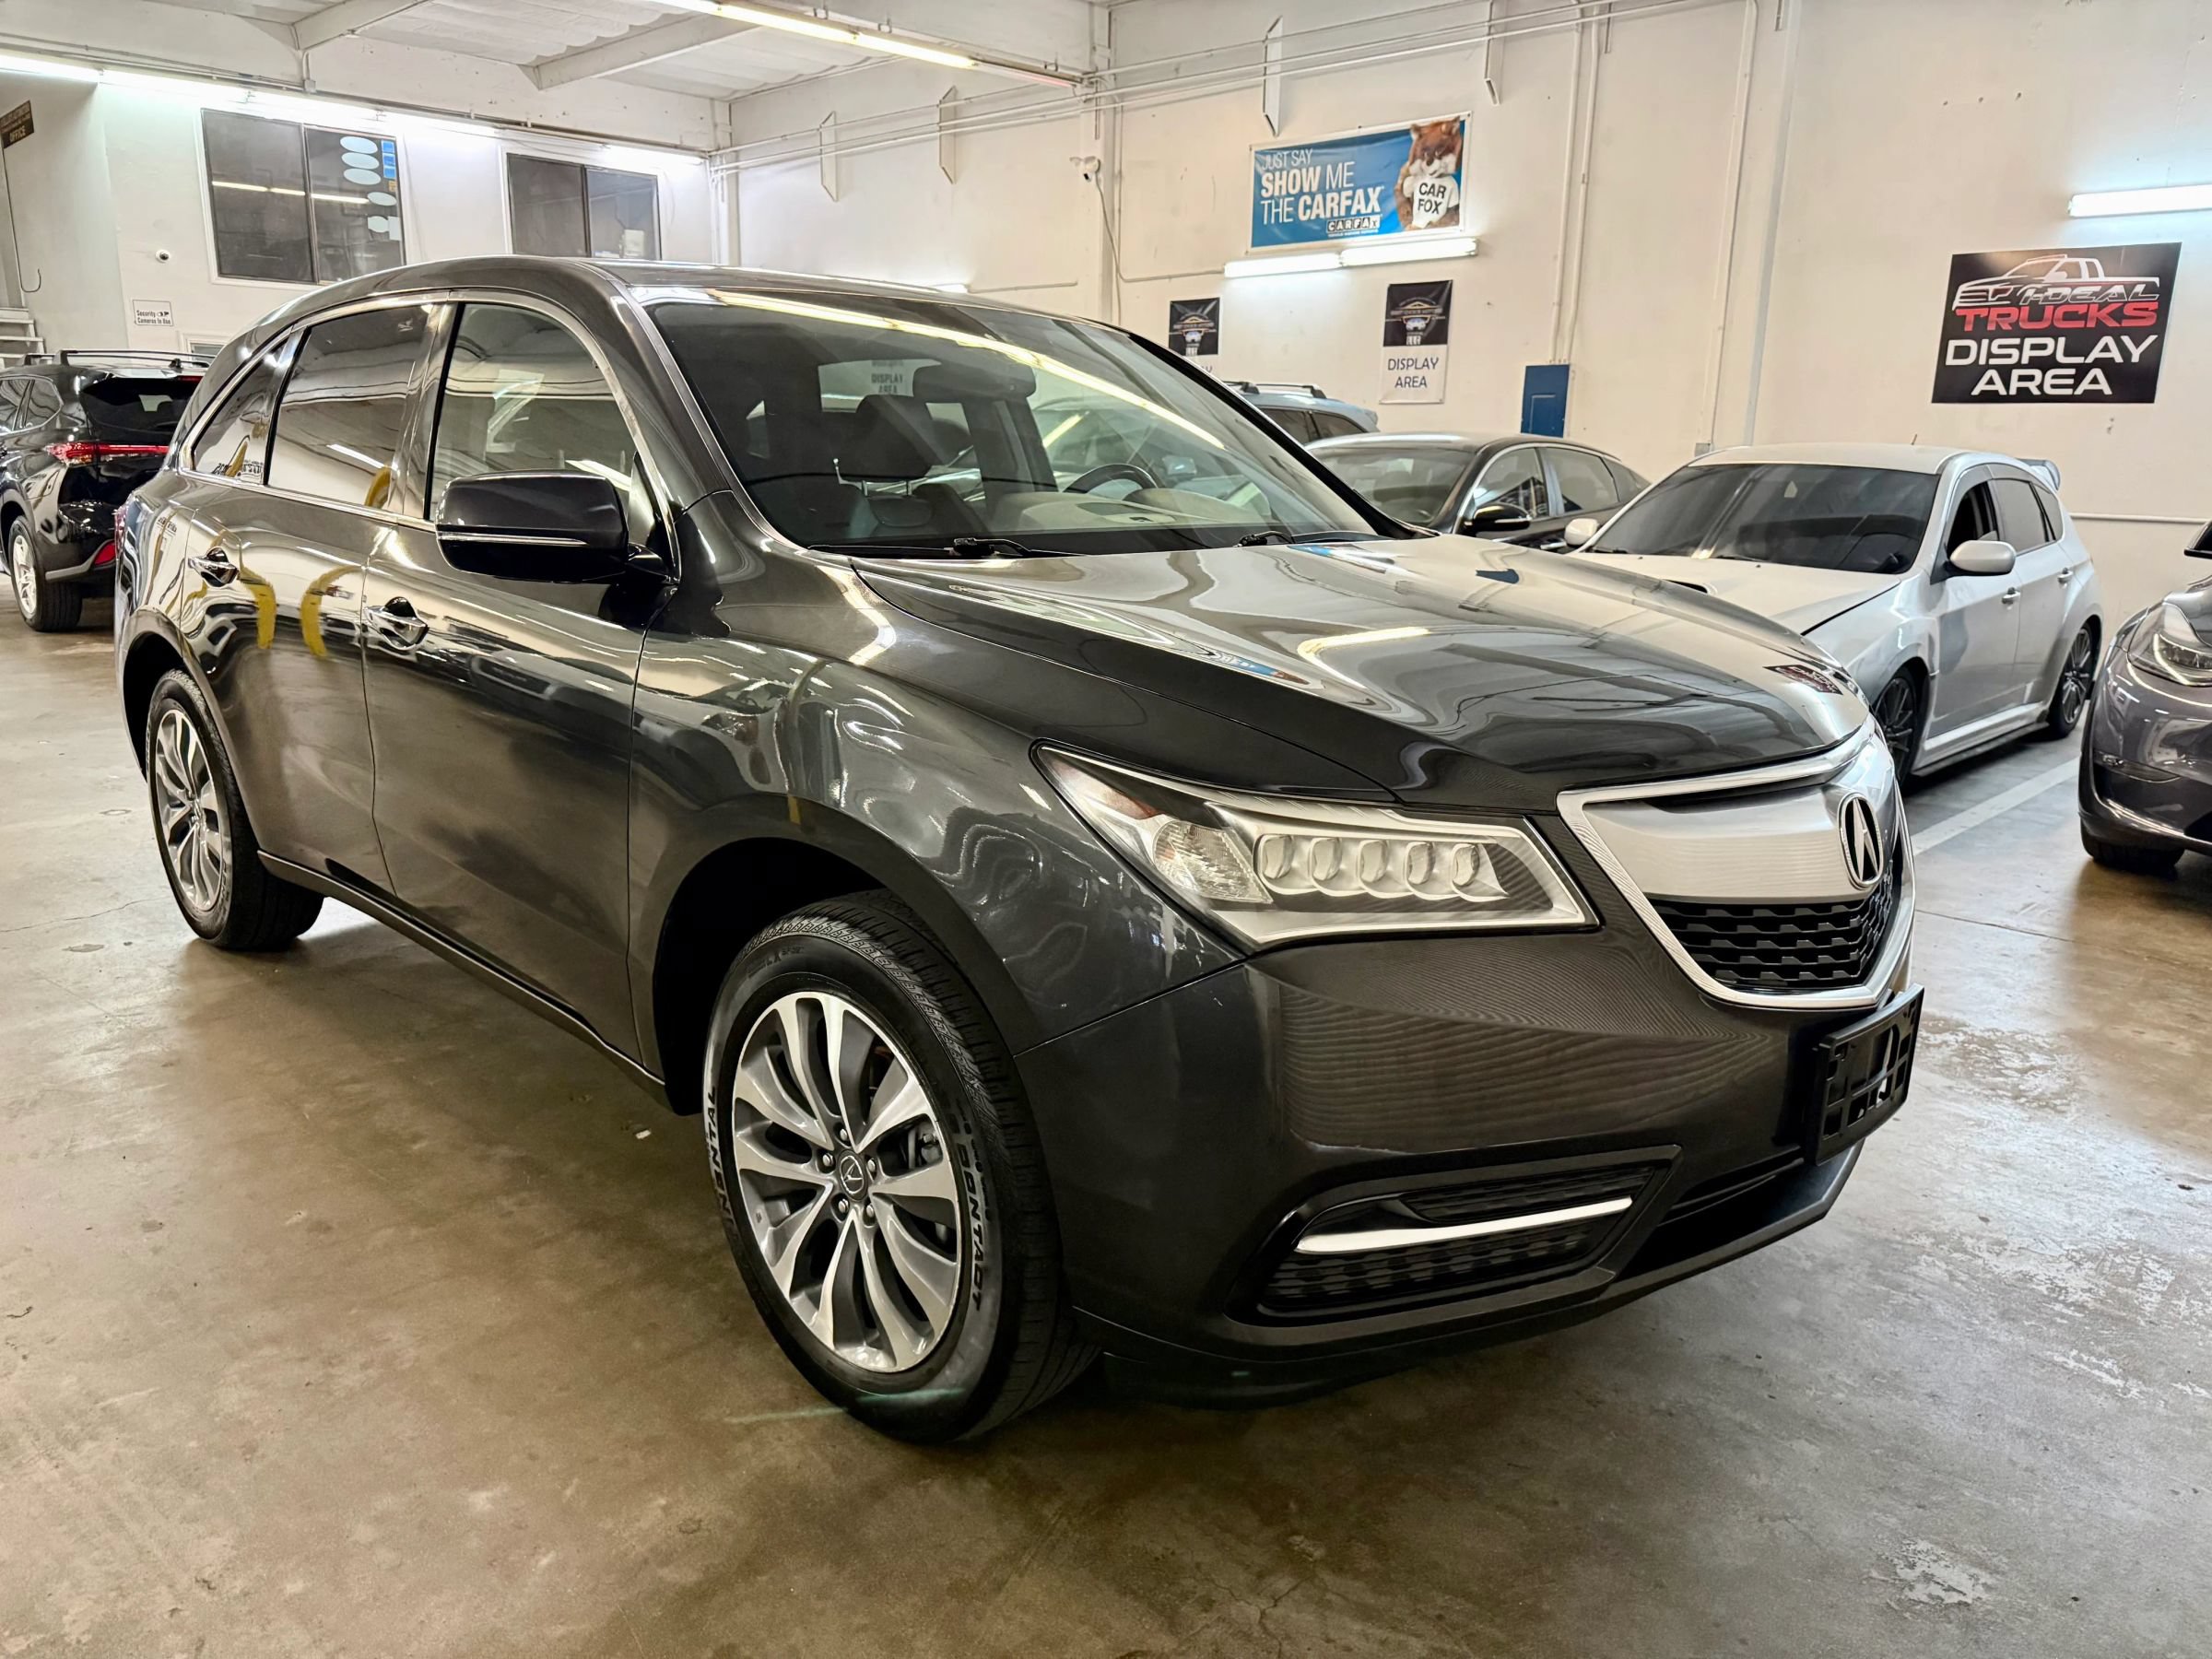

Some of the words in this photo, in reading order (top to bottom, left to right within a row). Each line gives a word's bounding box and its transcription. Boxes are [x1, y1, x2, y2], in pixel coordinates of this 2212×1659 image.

[1262, 151, 1290, 171] JUST
[1292, 148, 1312, 169] SAY
[1261, 166, 1321, 198] SHOW
[1325, 161, 1355, 188] ME
[1418, 182, 1447, 198] CAR
[1261, 197, 1294, 225] THE
[1298, 187, 1382, 221] CARFAX
[1417, 198, 1443, 215] FOX
[1327, 216, 1381, 232] CARFAX
[136, 310, 156, 318] Security
[1955, 301, 2159, 332] TRUCKS
[1945, 335, 2159, 366] DISPLAY
[1387, 357, 1440, 371] DISPLAY
[871, 373, 903, 383] DISPLAY
[1394, 376, 1428, 388] AREA
[1971, 368, 2112, 396] AREA
